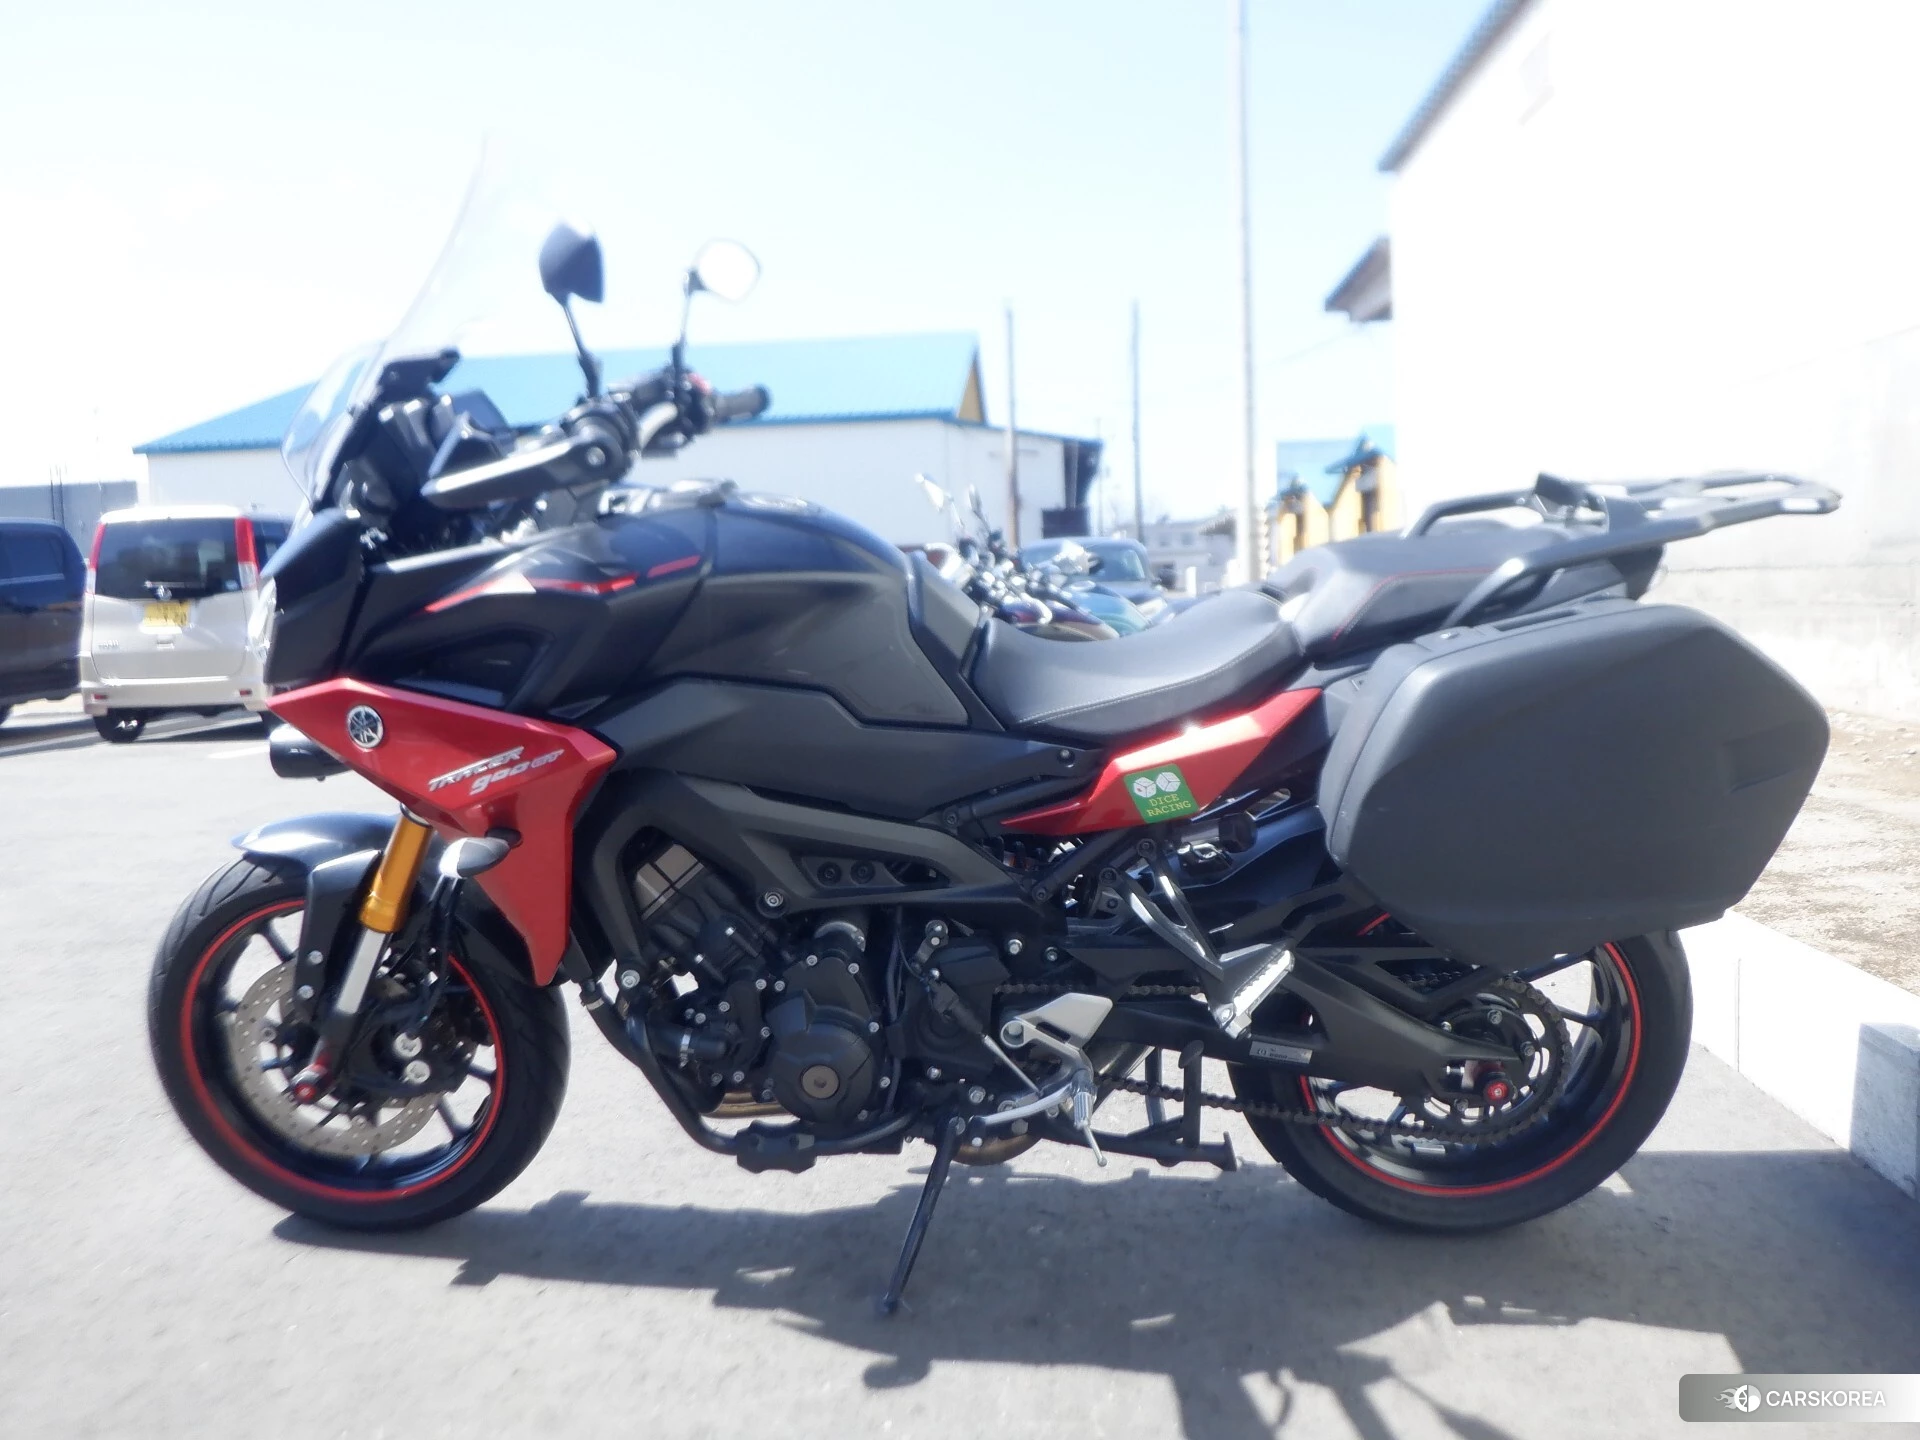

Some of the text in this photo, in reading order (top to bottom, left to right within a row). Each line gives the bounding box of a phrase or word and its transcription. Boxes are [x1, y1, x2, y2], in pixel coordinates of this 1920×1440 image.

[428, 745, 525, 792] TRACER
[468, 761, 531, 796] 900
[1146, 800, 1192, 817] RACING
[1149, 793, 1181, 807] DICE
